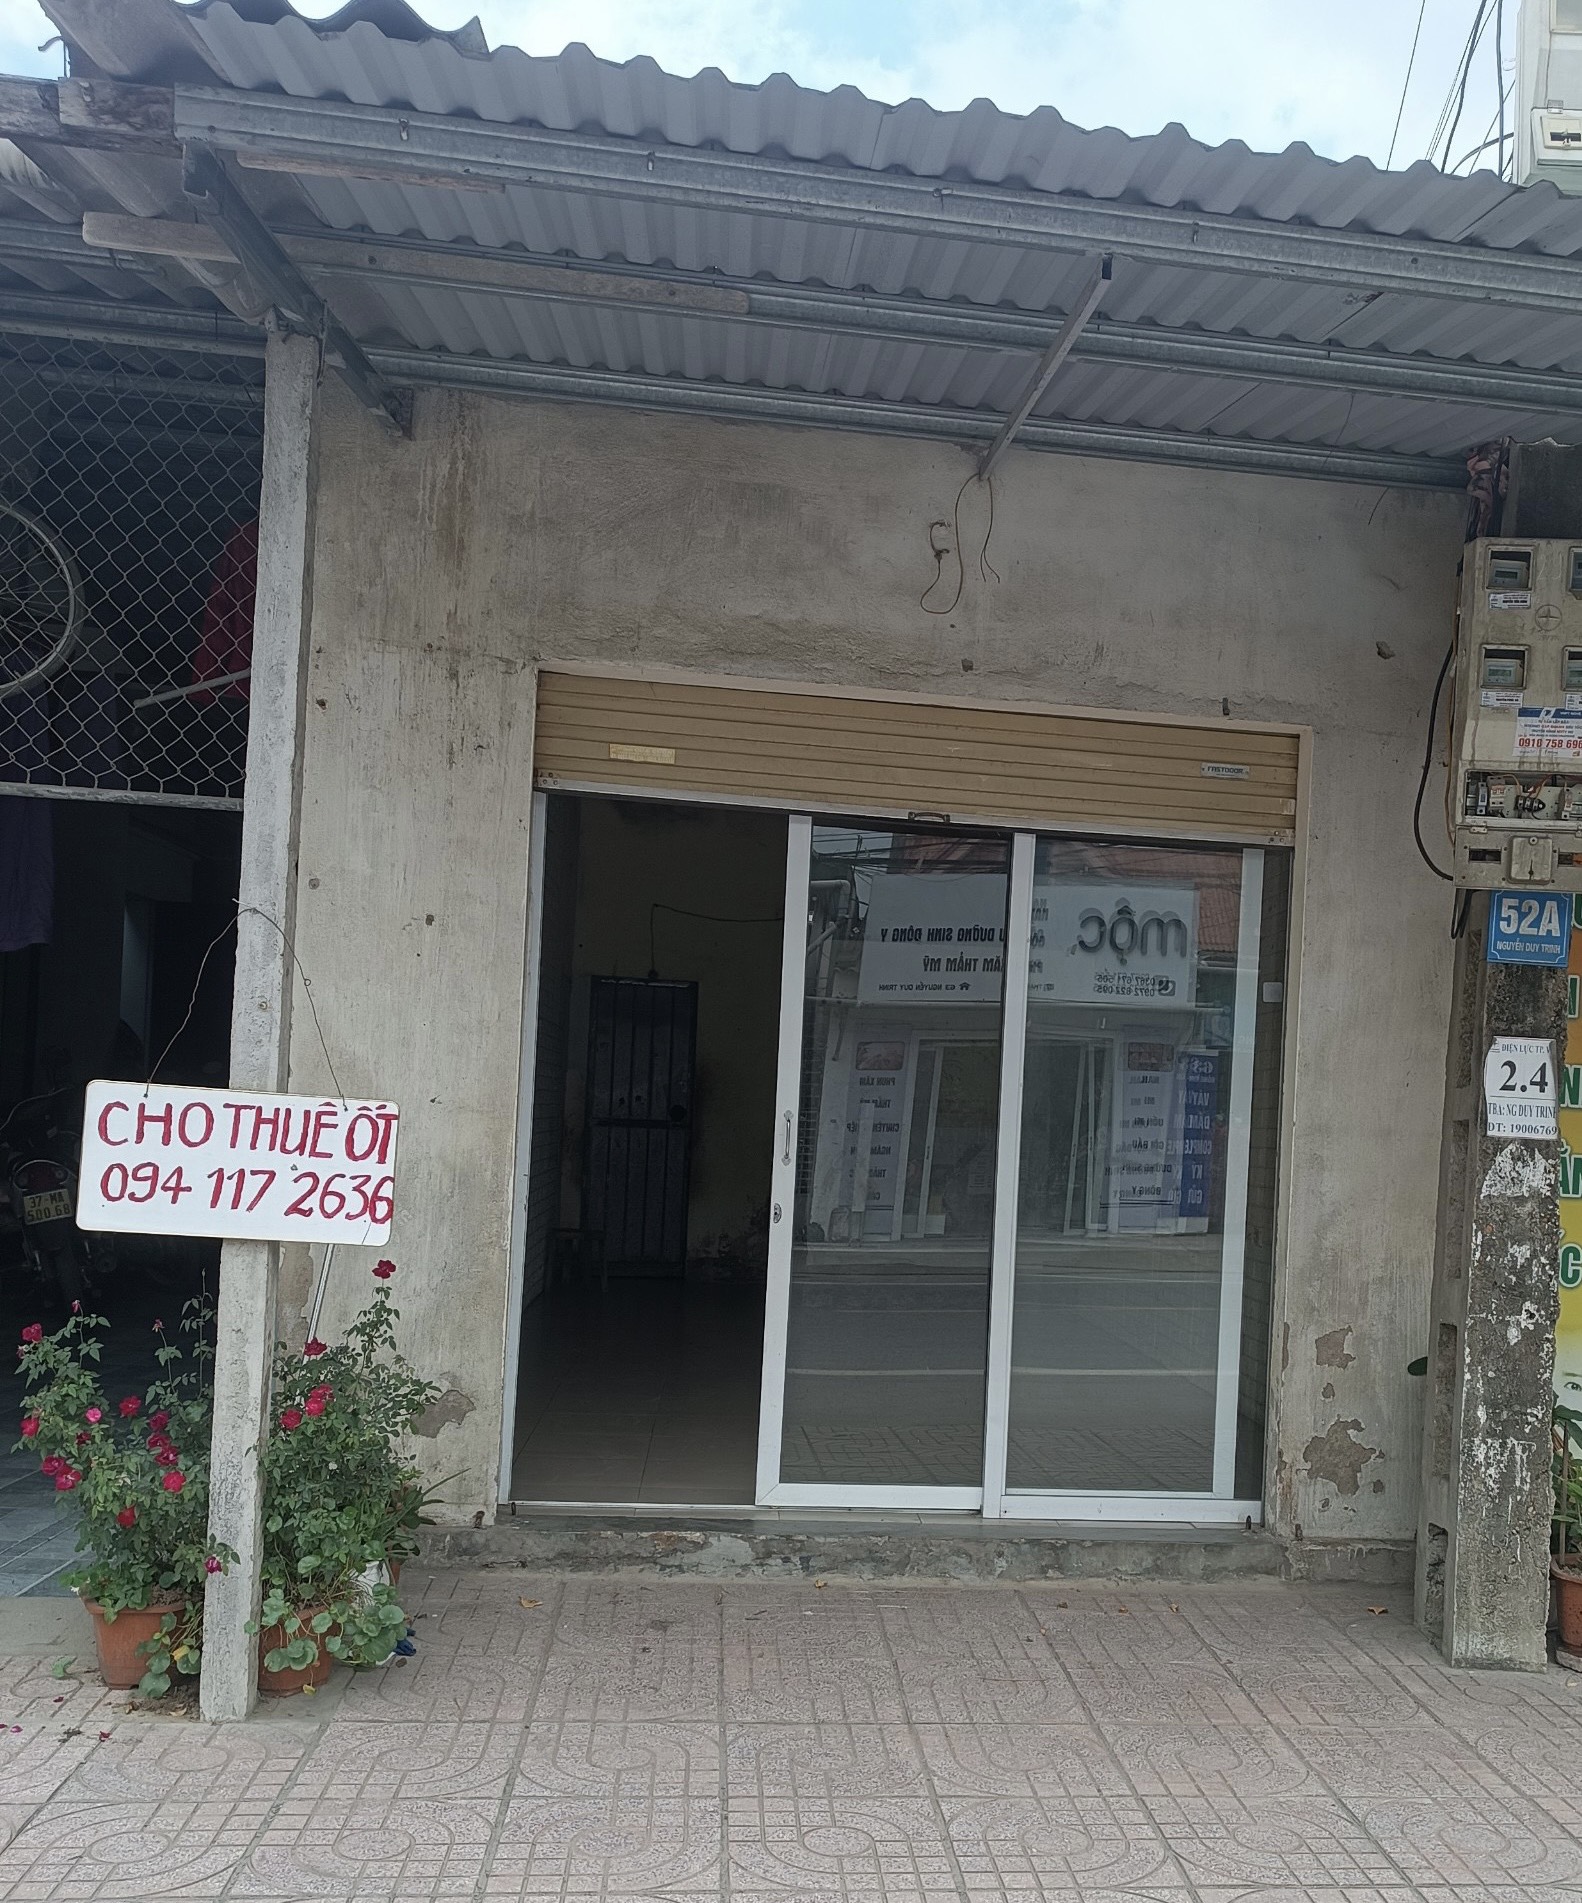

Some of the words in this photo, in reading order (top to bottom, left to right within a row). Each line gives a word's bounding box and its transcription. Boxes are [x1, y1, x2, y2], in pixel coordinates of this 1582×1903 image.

[1545, 739, 1563, 748] 758
[1499, 898, 1561, 937] 52A
[1525, 943, 1540, 952] DUY
[1541, 944, 1561, 954] TRINH
[1499, 1060, 1548, 1093] 2.4
[1488, 1103, 1505, 1116] TBA:
[1506, 1103, 1517, 1116] NG
[1518, 1105, 1534, 1118] DUY
[98, 1101, 215, 1147] CHO
[223, 1101, 339, 1159] THUÊ
[1510, 1123, 1558, 1136] 19006769
[100, 1161, 192, 1204] 094
[207, 1167, 277, 1212] 117
[284, 1171, 395, 1224] 2636
